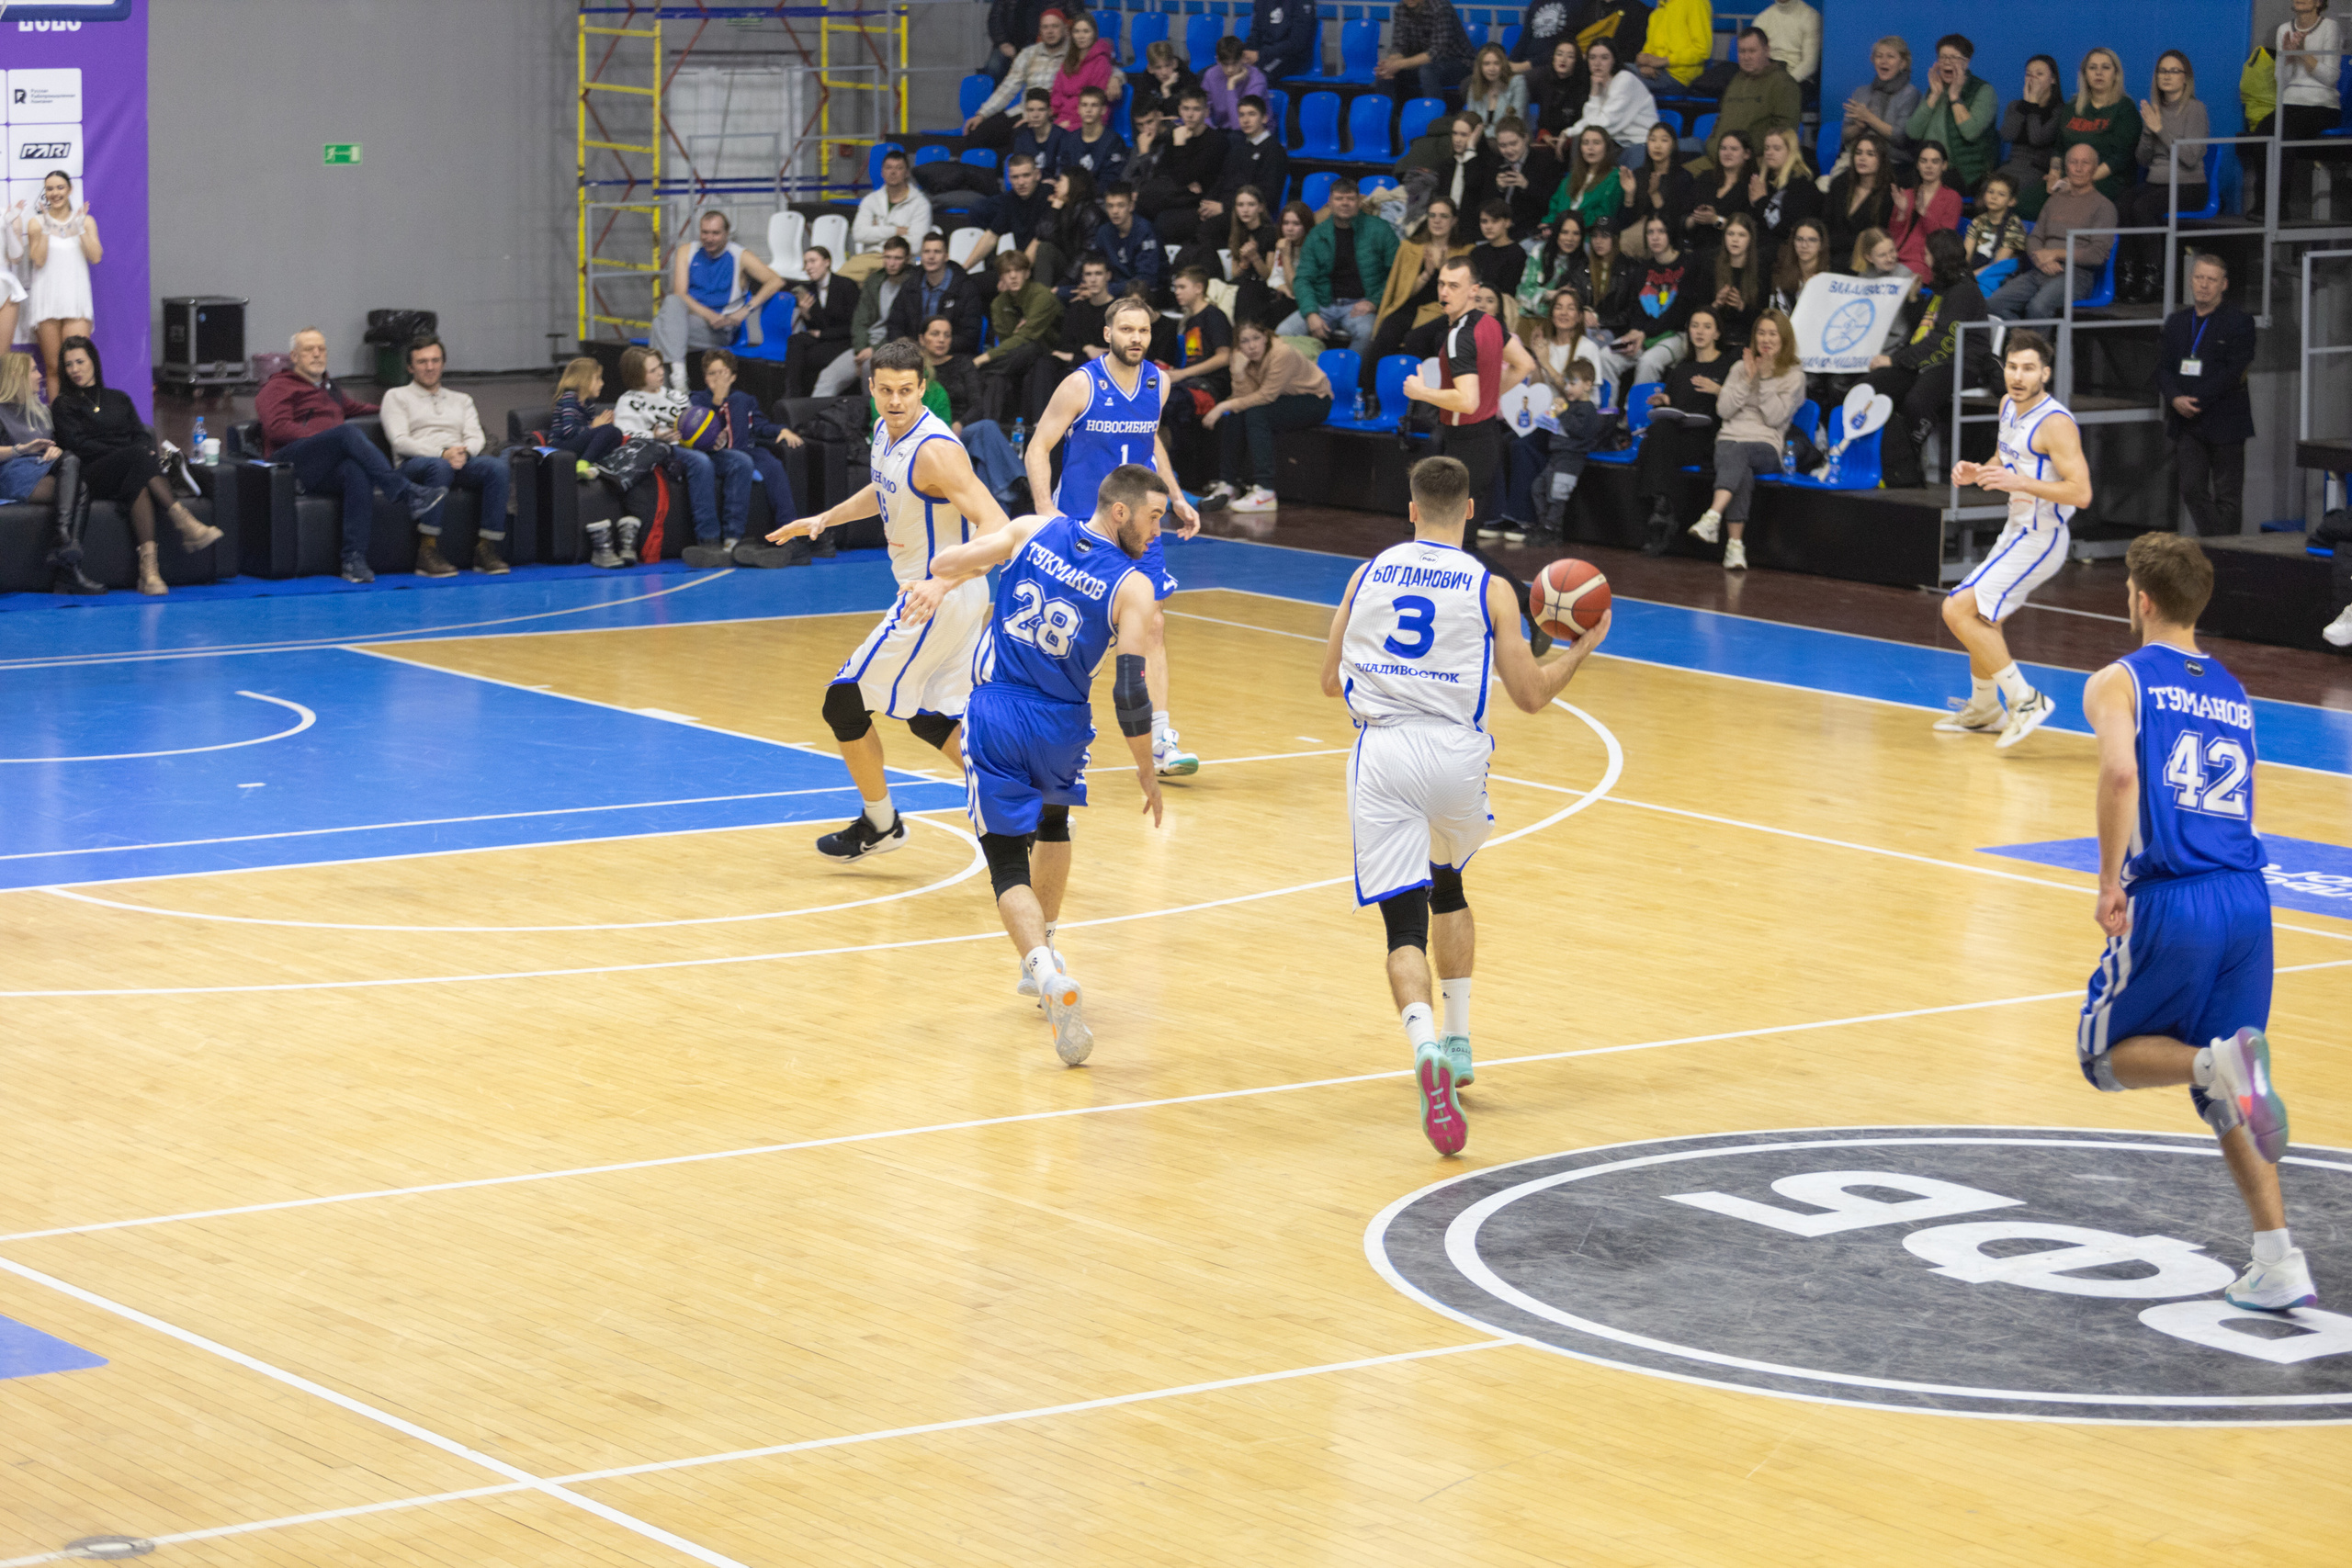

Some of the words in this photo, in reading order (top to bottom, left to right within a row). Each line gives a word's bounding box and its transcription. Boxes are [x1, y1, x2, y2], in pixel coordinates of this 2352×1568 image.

[20, 142, 71, 159] PARI
[1118, 444, 1129, 466] 1
[1026, 541, 1107, 601] ТУКМАКОВ
[1372, 564, 1473, 592] БОГДАНОВИЧ
[1002, 578, 1083, 660] 28
[1383, 594, 1436, 660] 3
[2147, 685, 2252, 730] ТУМАНОВ
[2163, 729, 2248, 820] 42
